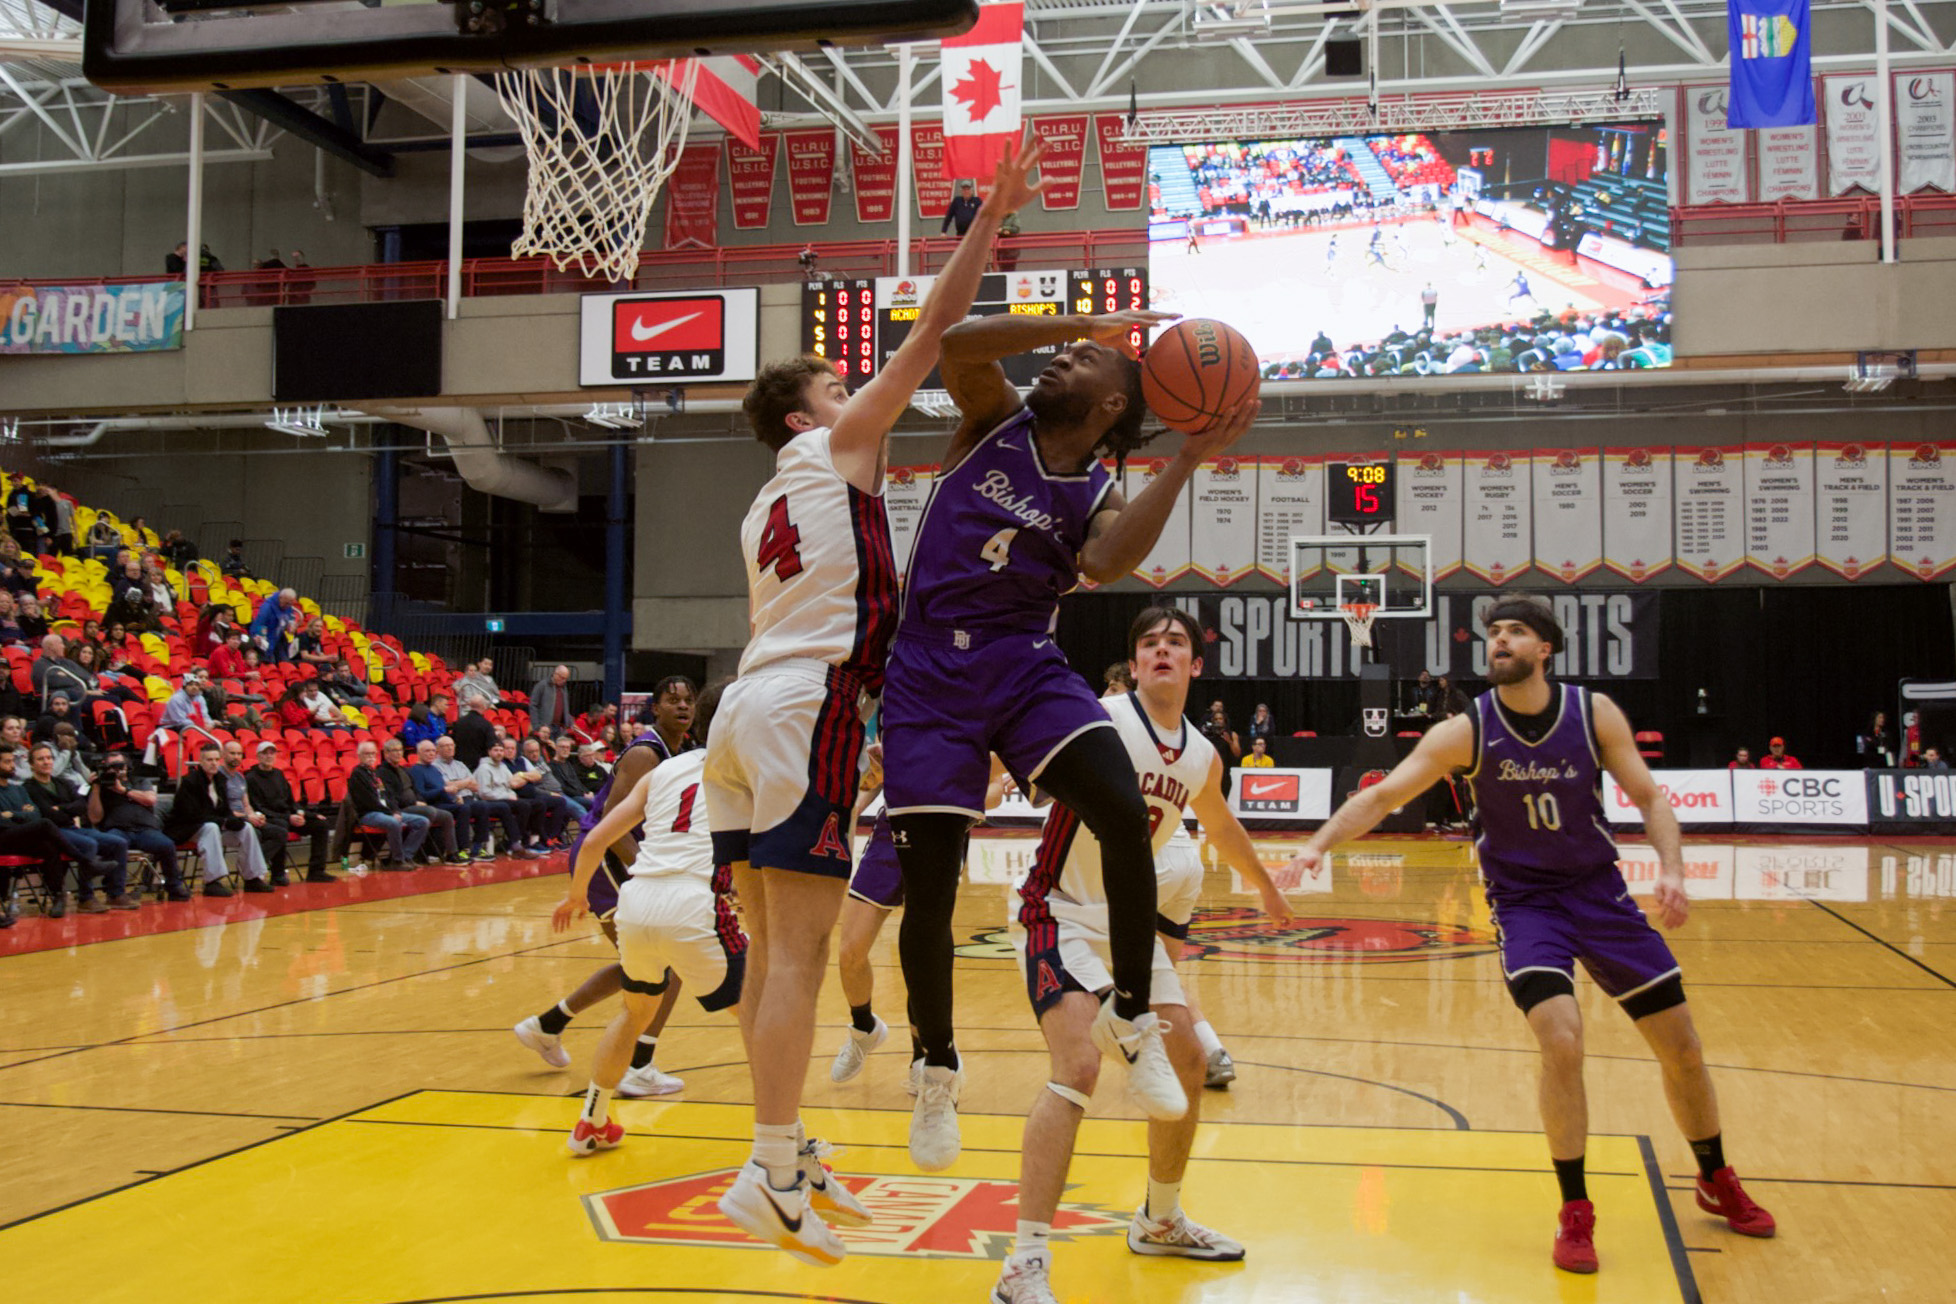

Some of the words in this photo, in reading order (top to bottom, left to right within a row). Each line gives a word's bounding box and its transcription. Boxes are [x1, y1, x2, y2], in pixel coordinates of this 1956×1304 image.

[838, 290, 848, 306] 0
[861, 289, 872, 305] 0
[1081, 281, 1093, 295] 4
[1105, 280, 1116, 295] 0
[1130, 278, 1141, 294] 0
[814, 309, 826, 323] 4
[838, 308, 848, 324] 0
[861, 306, 872, 322] 0
[1010, 303, 1057, 316] BISHOP'S
[1105, 298, 1116, 312] 0
[11, 291, 168, 344] GARDEN
[838, 325, 848, 341] 0
[861, 324, 872, 340] 0
[860, 341, 872, 357] 0
[626, 355, 710, 372] TEAM
[860, 358, 872, 374] 0
[1346, 466, 1386, 484] 9:08
[1354, 484, 1379, 513] 15
[757, 493, 804, 583] 4
[979, 527, 1019, 573] 4
[1220, 597, 1373, 677] SPORT
[1472, 595, 1632, 676] SRTS
[1497, 758, 1578, 784] Bishop's
[1136, 772, 1189, 814] CADIA
[1782, 778, 1841, 798] CBC
[1878, 775, 1896, 817] U
[671, 783, 700, 832] 1
[1246, 801, 1292, 810] TEAM
[1522, 792, 1561, 831] 10
[1758, 799, 1844, 816] SPORTS
[810, 814, 850, 861] A
[1036, 959, 1062, 1001] A
